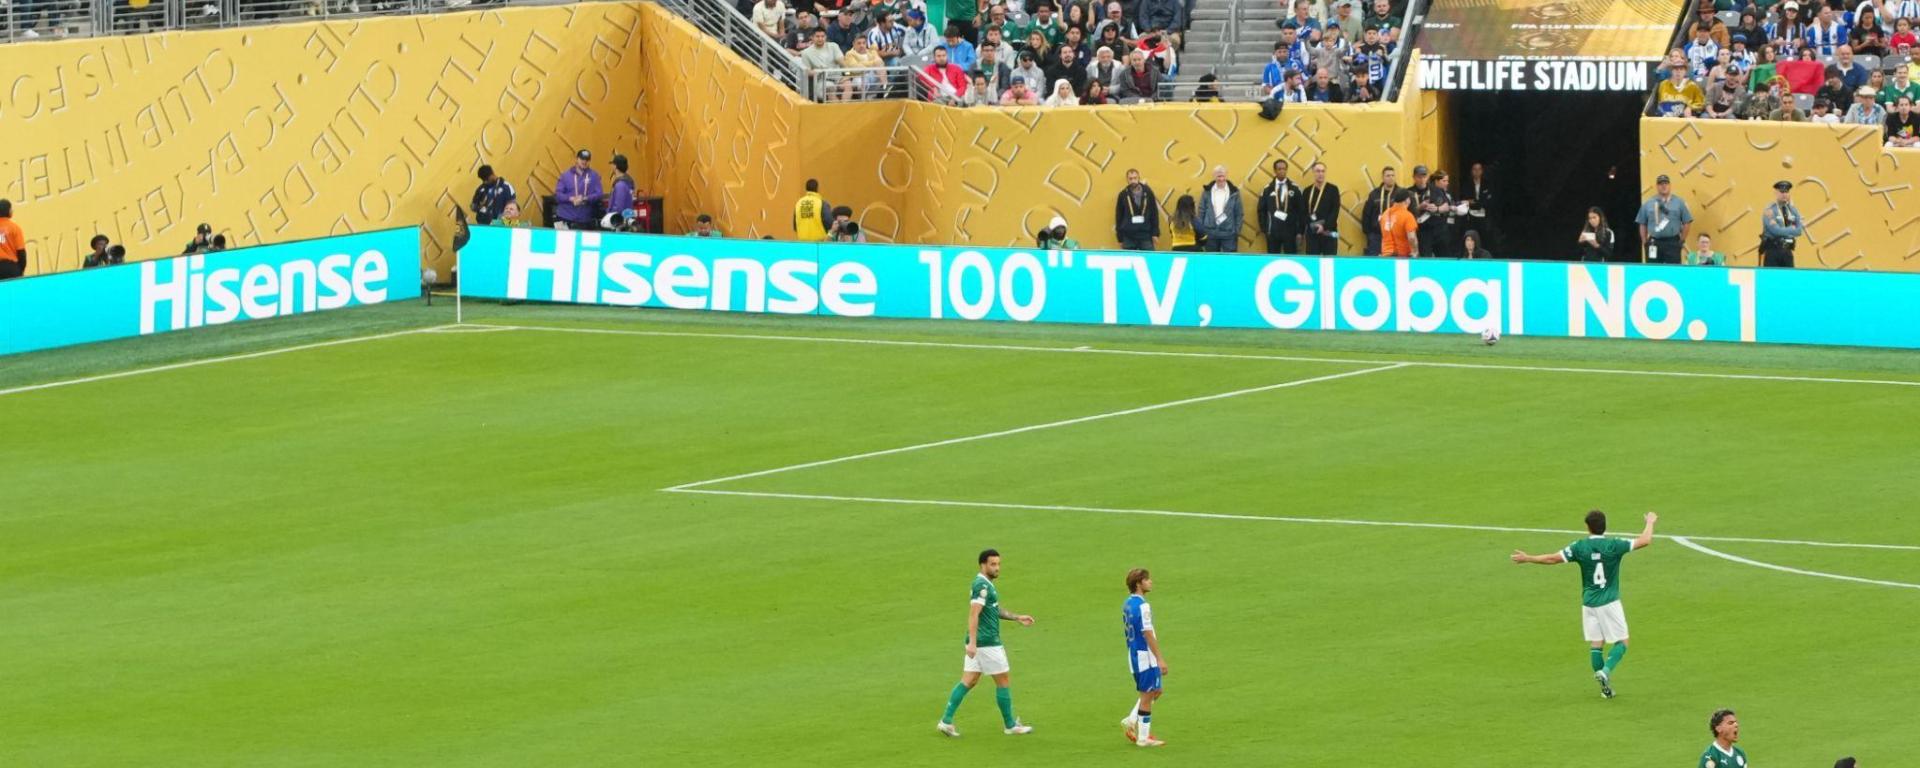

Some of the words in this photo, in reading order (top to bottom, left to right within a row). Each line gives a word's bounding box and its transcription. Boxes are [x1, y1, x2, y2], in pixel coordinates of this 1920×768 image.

[1419, 60, 1527, 91] METLIFE
[1533, 61, 1648, 91] STADIUM
[139, 249, 389, 336] Hisense
[506, 227, 877, 317] Hisense
[919, 249, 1072, 322] 100"
[1087, 254, 1211, 327] TV,
[1254, 256, 1524, 336] Global
[1567, 262, 1708, 341] No.
[1728, 267, 1757, 343] 1
[1593, 562, 1607, 589] 4
